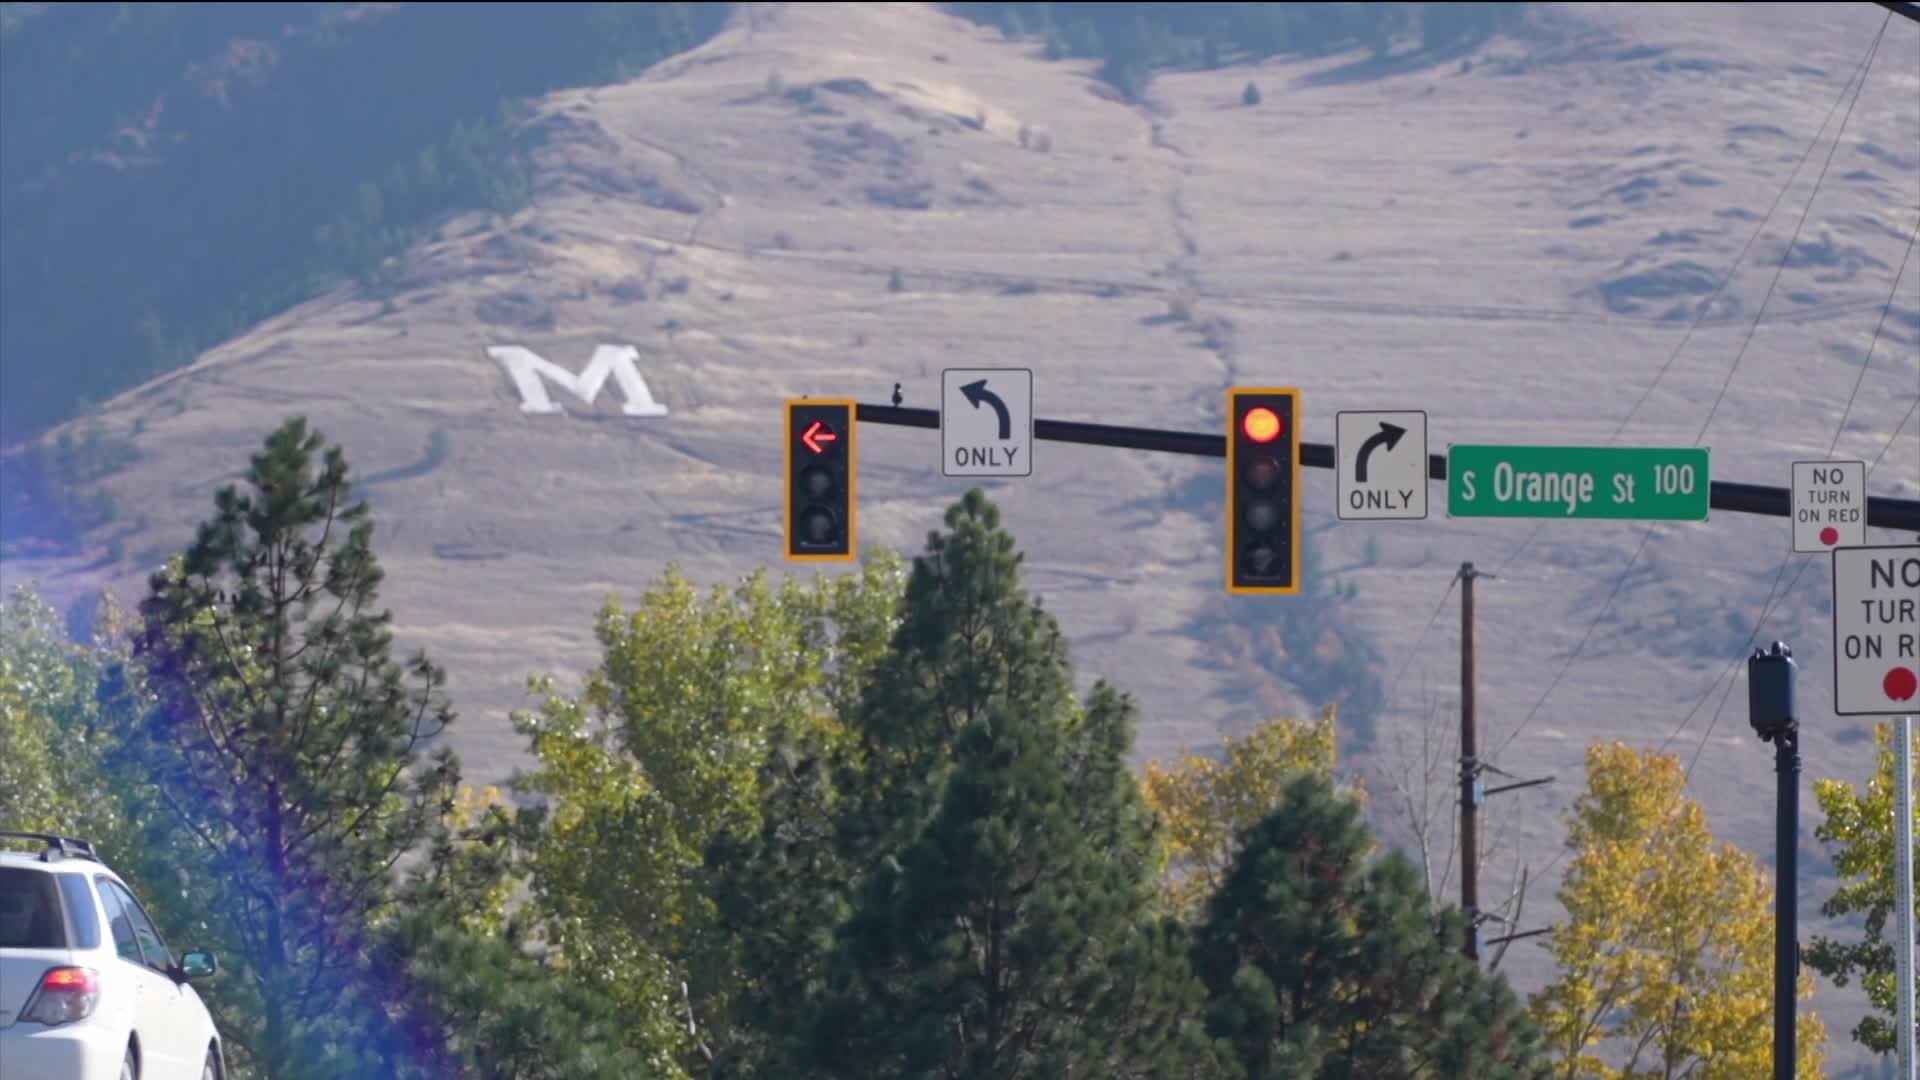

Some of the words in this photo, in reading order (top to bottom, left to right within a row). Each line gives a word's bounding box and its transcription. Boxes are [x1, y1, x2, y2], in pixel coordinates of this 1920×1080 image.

[486, 344, 668, 415] M
[955, 446, 1018, 467] ONLY
[1461, 470, 1476, 501] S
[1493, 461, 1594, 515] Orange
[1612, 472, 1636, 504] St
[1653, 464, 1695, 495] 100
[1813, 468, 1844, 485] NO
[1350, 489, 1414, 509] ONLY
[1808, 490, 1850, 504] TURN
[1798, 508, 1820, 523] ON
[1828, 508, 1860, 523] RED
[1871, 558, 1920, 588] NO
[1860, 599, 1920, 624] TUR
[1845, 633, 1882, 659] ON
